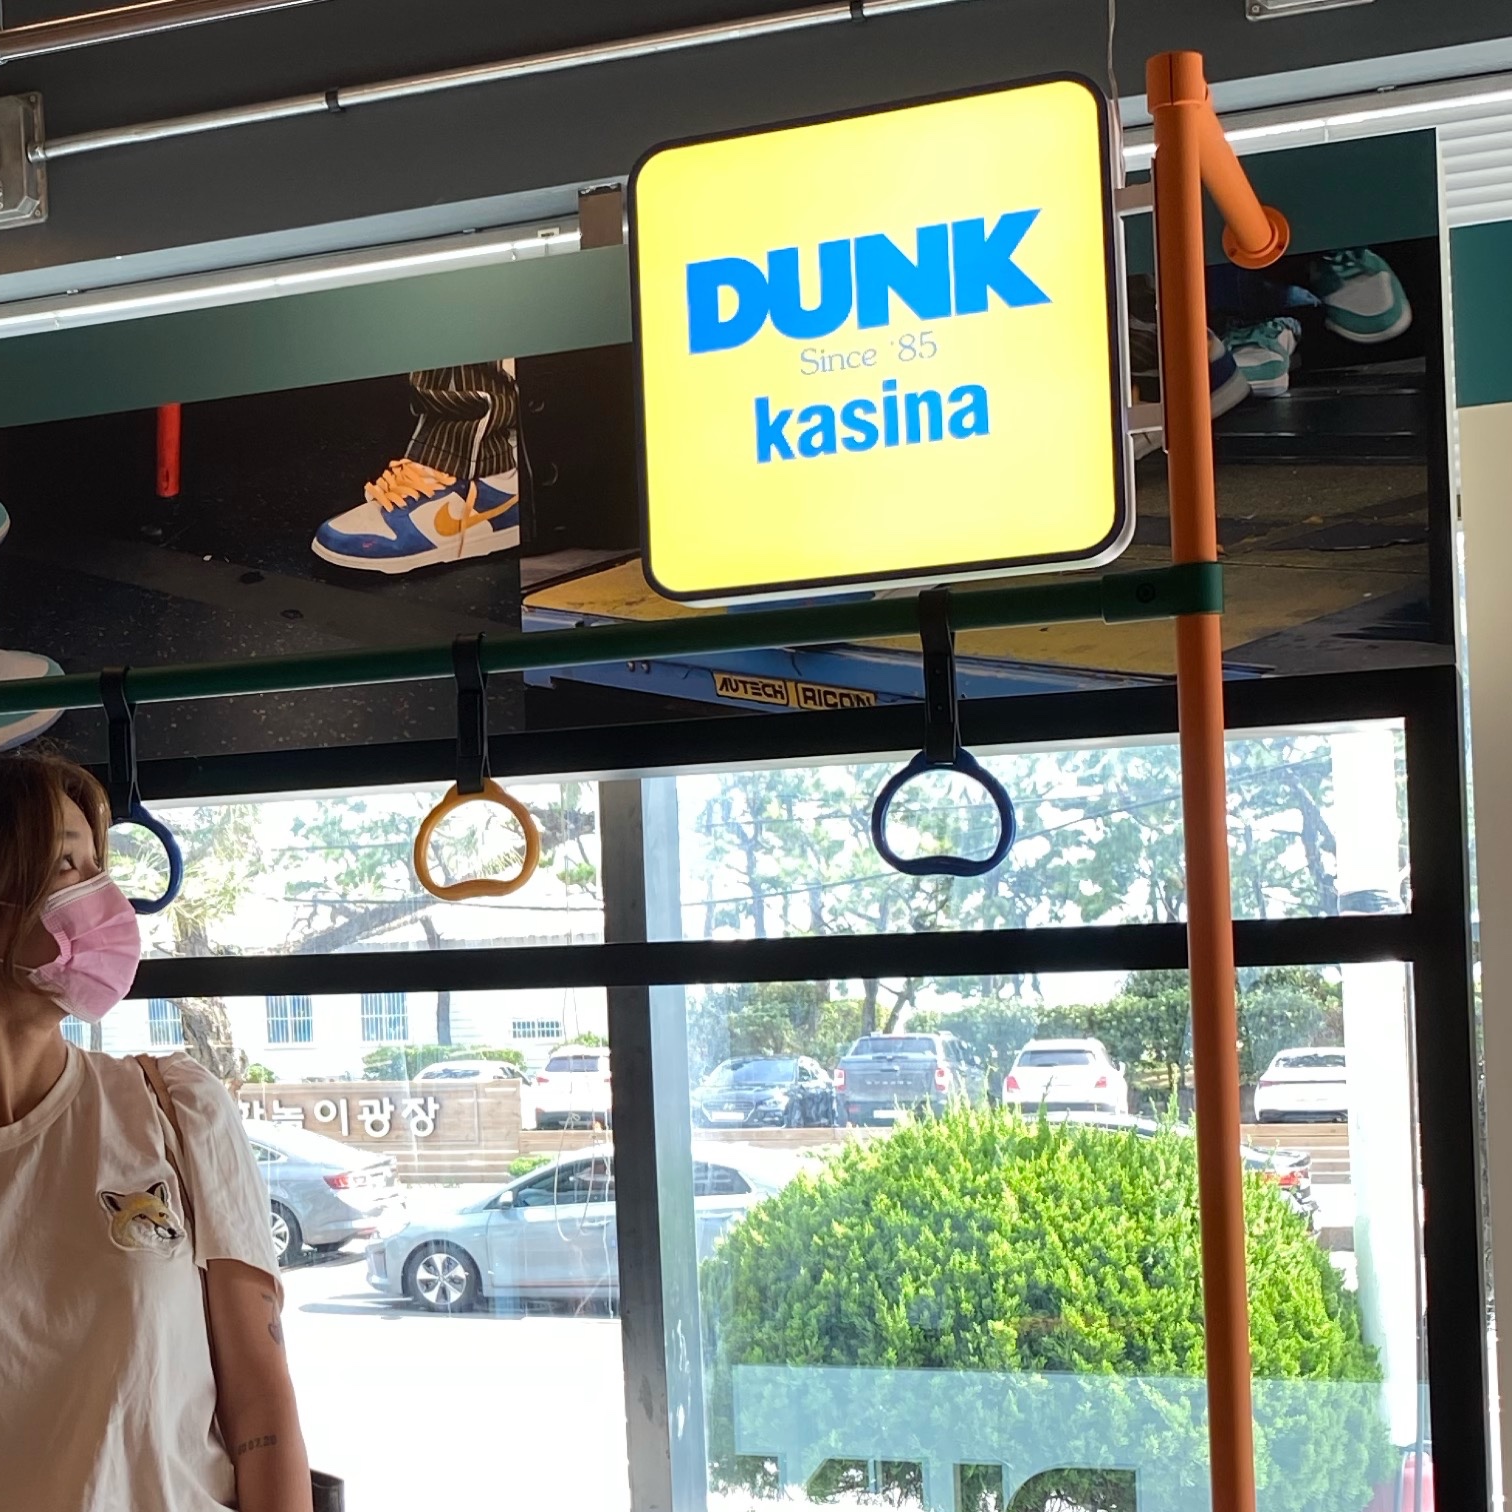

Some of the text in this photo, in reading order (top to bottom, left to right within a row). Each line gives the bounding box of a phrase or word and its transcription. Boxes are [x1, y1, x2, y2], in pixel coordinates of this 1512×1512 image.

[686, 208, 1053, 355] DUNK
[800, 346, 877, 375] Since
[754, 379, 991, 464] kasina
